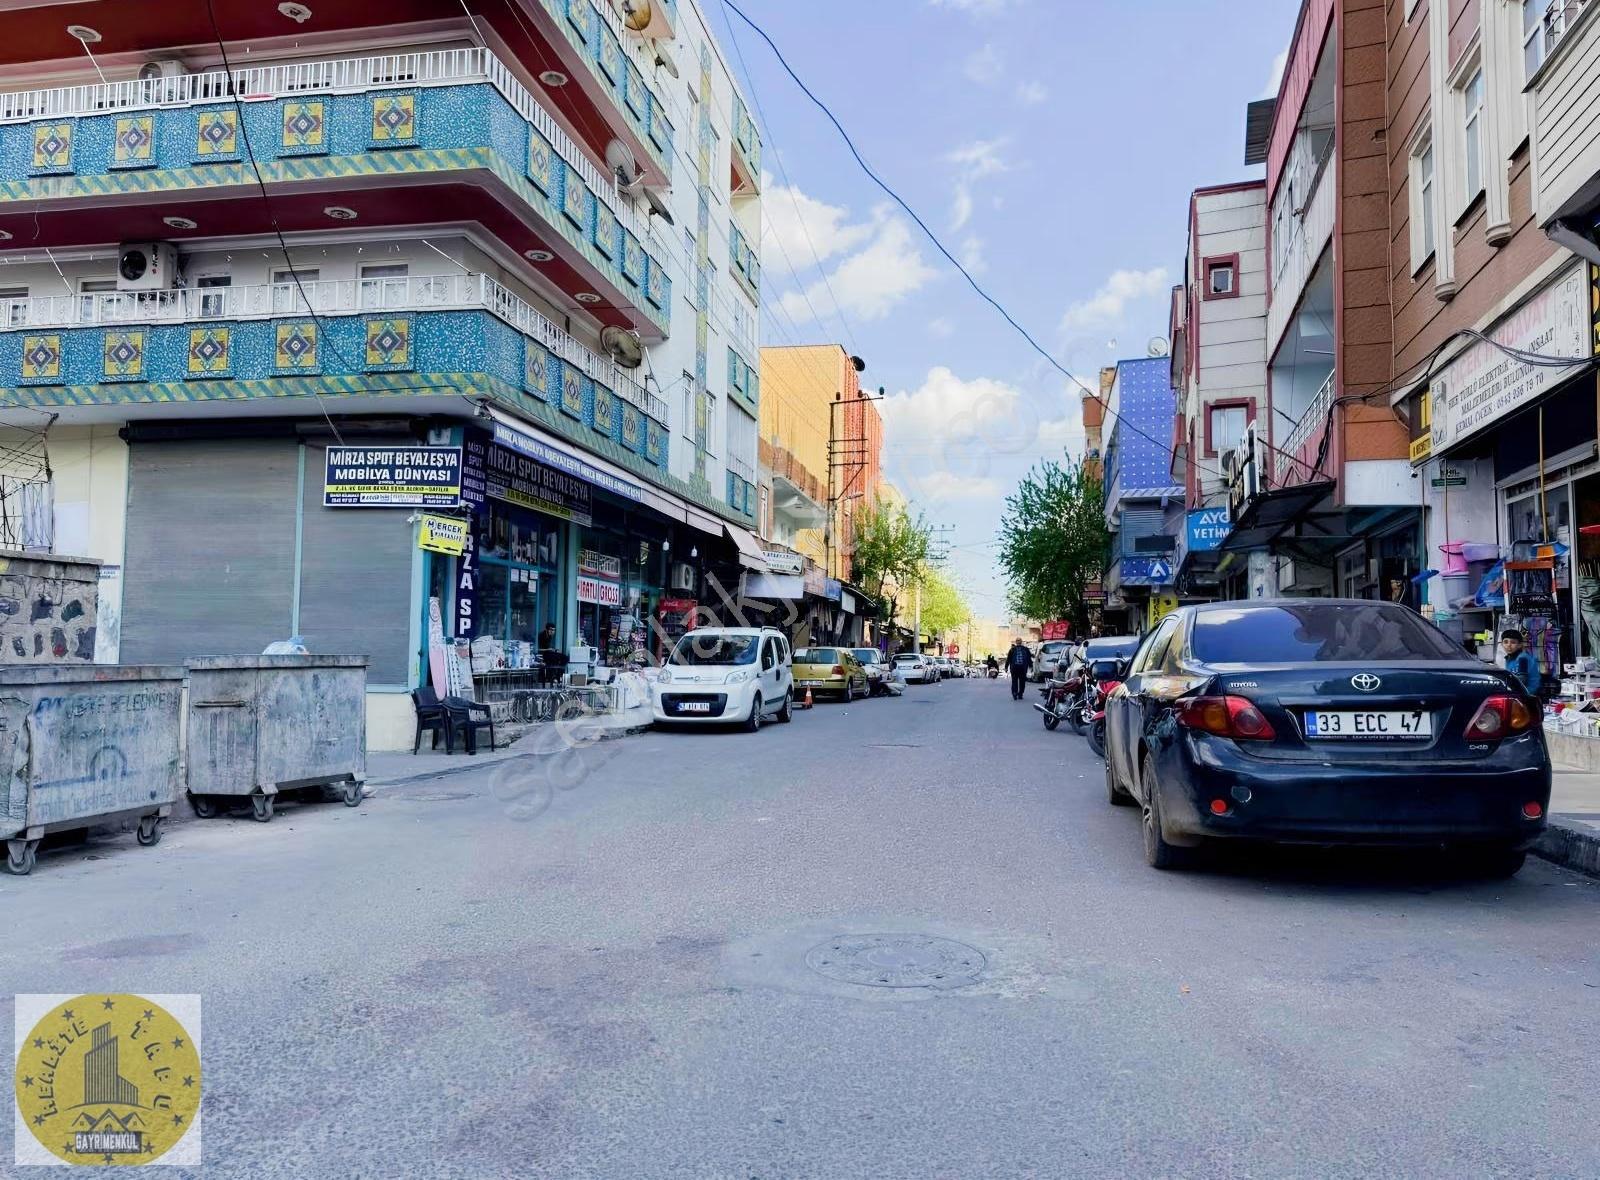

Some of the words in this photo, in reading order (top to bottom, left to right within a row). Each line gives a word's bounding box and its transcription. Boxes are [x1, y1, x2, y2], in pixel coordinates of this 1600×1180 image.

[330, 450, 366, 466] MİRZA
[366, 452, 395, 466] SPOT
[396, 452, 430, 466] BEYAZ
[430, 453, 458, 468] EŞYA
[335, 467, 390, 481] MOBİLYA
[394, 467, 451, 482] DÜNYASI
[518, 457, 543, 485] SPOT
[1318, 713, 1341, 732] 33
[1354, 713, 1388, 732] ECC
[1401, 711, 1423, 732] 47
